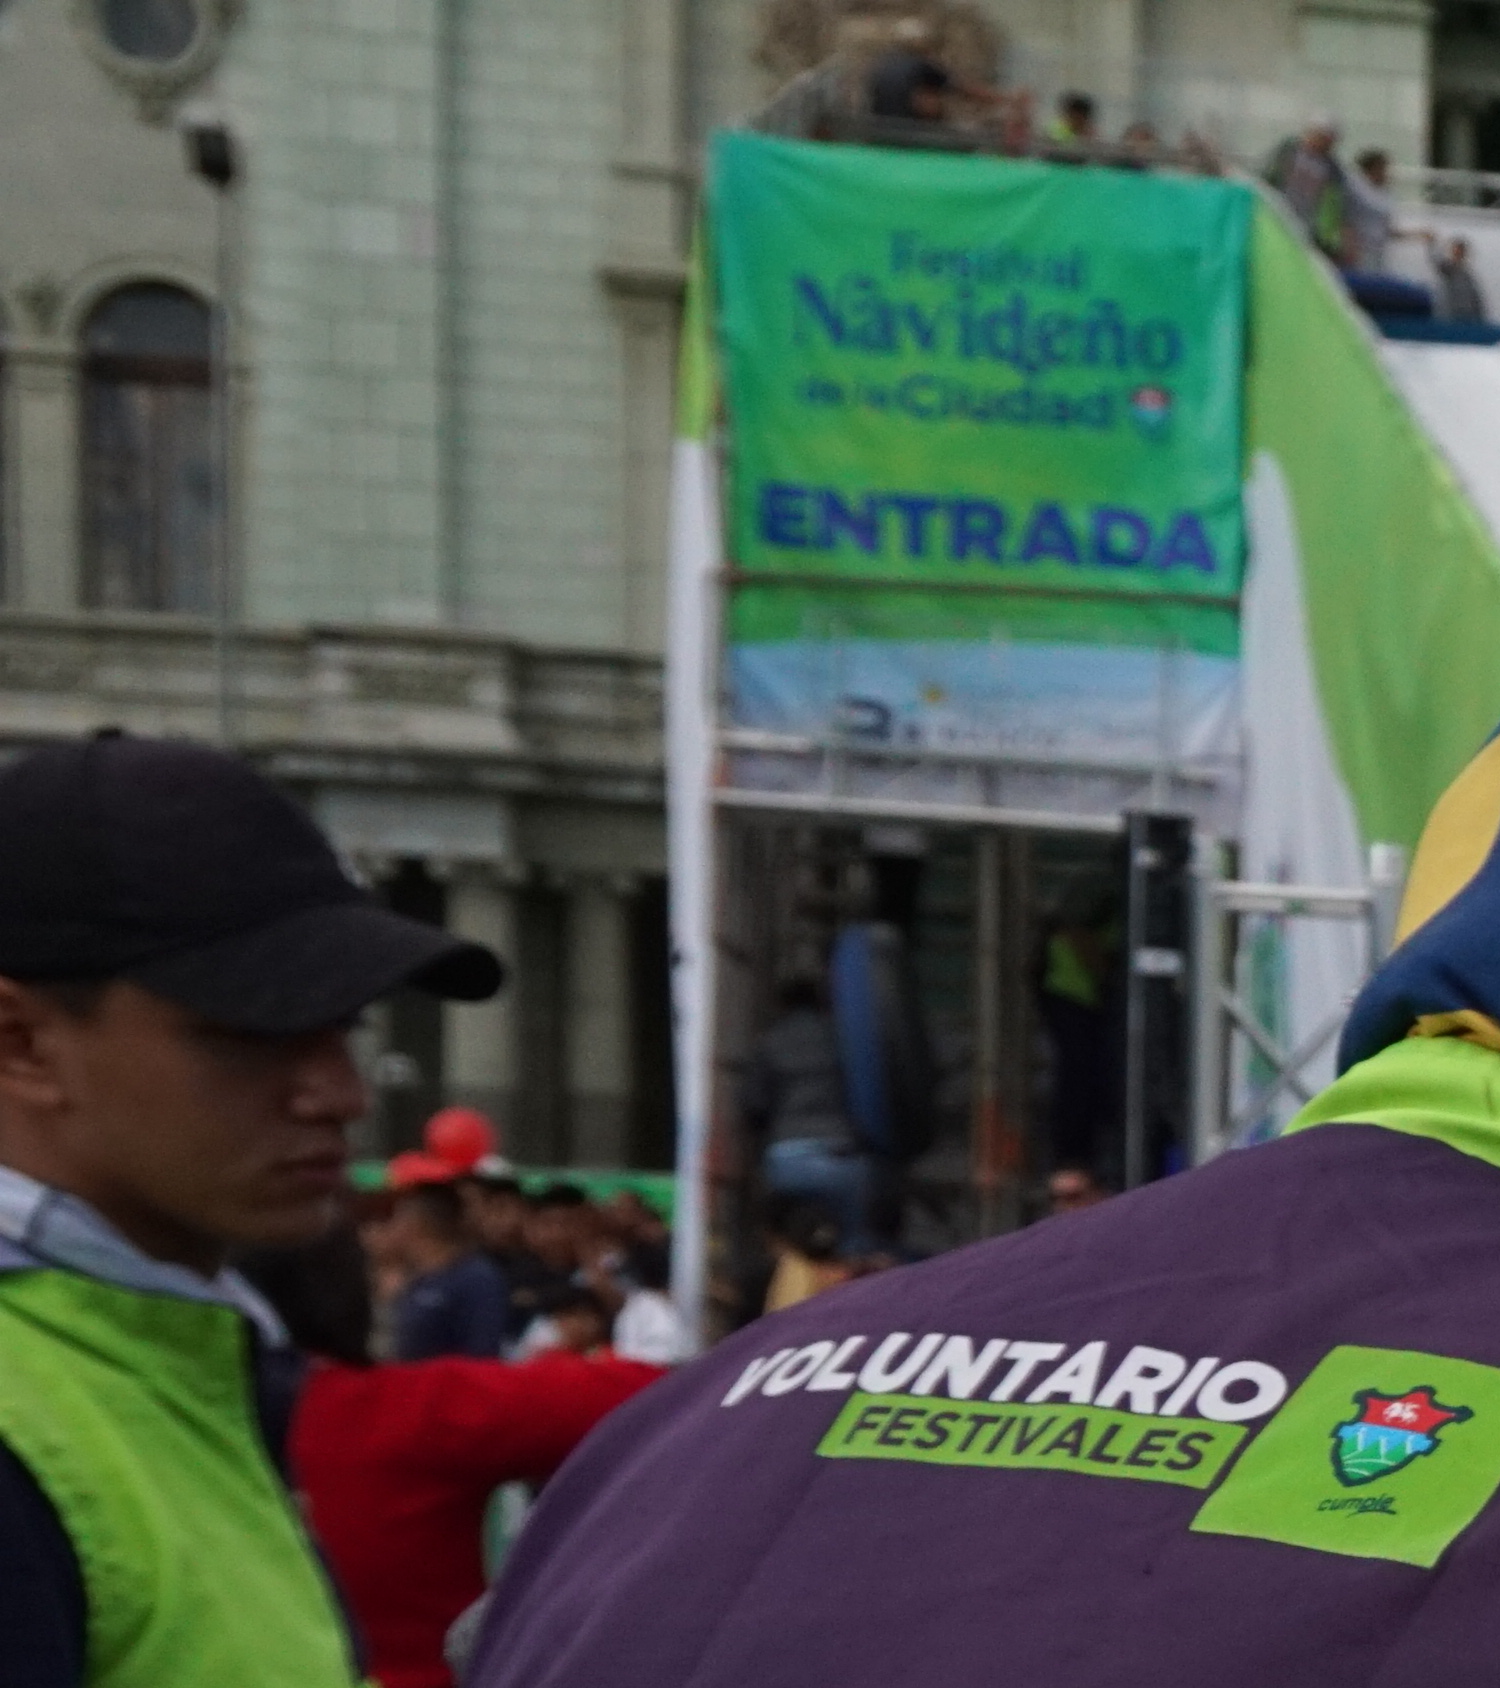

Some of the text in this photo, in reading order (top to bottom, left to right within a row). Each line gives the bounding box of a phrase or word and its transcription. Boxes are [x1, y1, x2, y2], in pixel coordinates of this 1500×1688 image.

[755, 478, 1217, 574] ENTRADA
[722, 1332, 1288, 1422] VOLUNTARIO
[842, 1405, 1213, 1472] FESTIVALES
